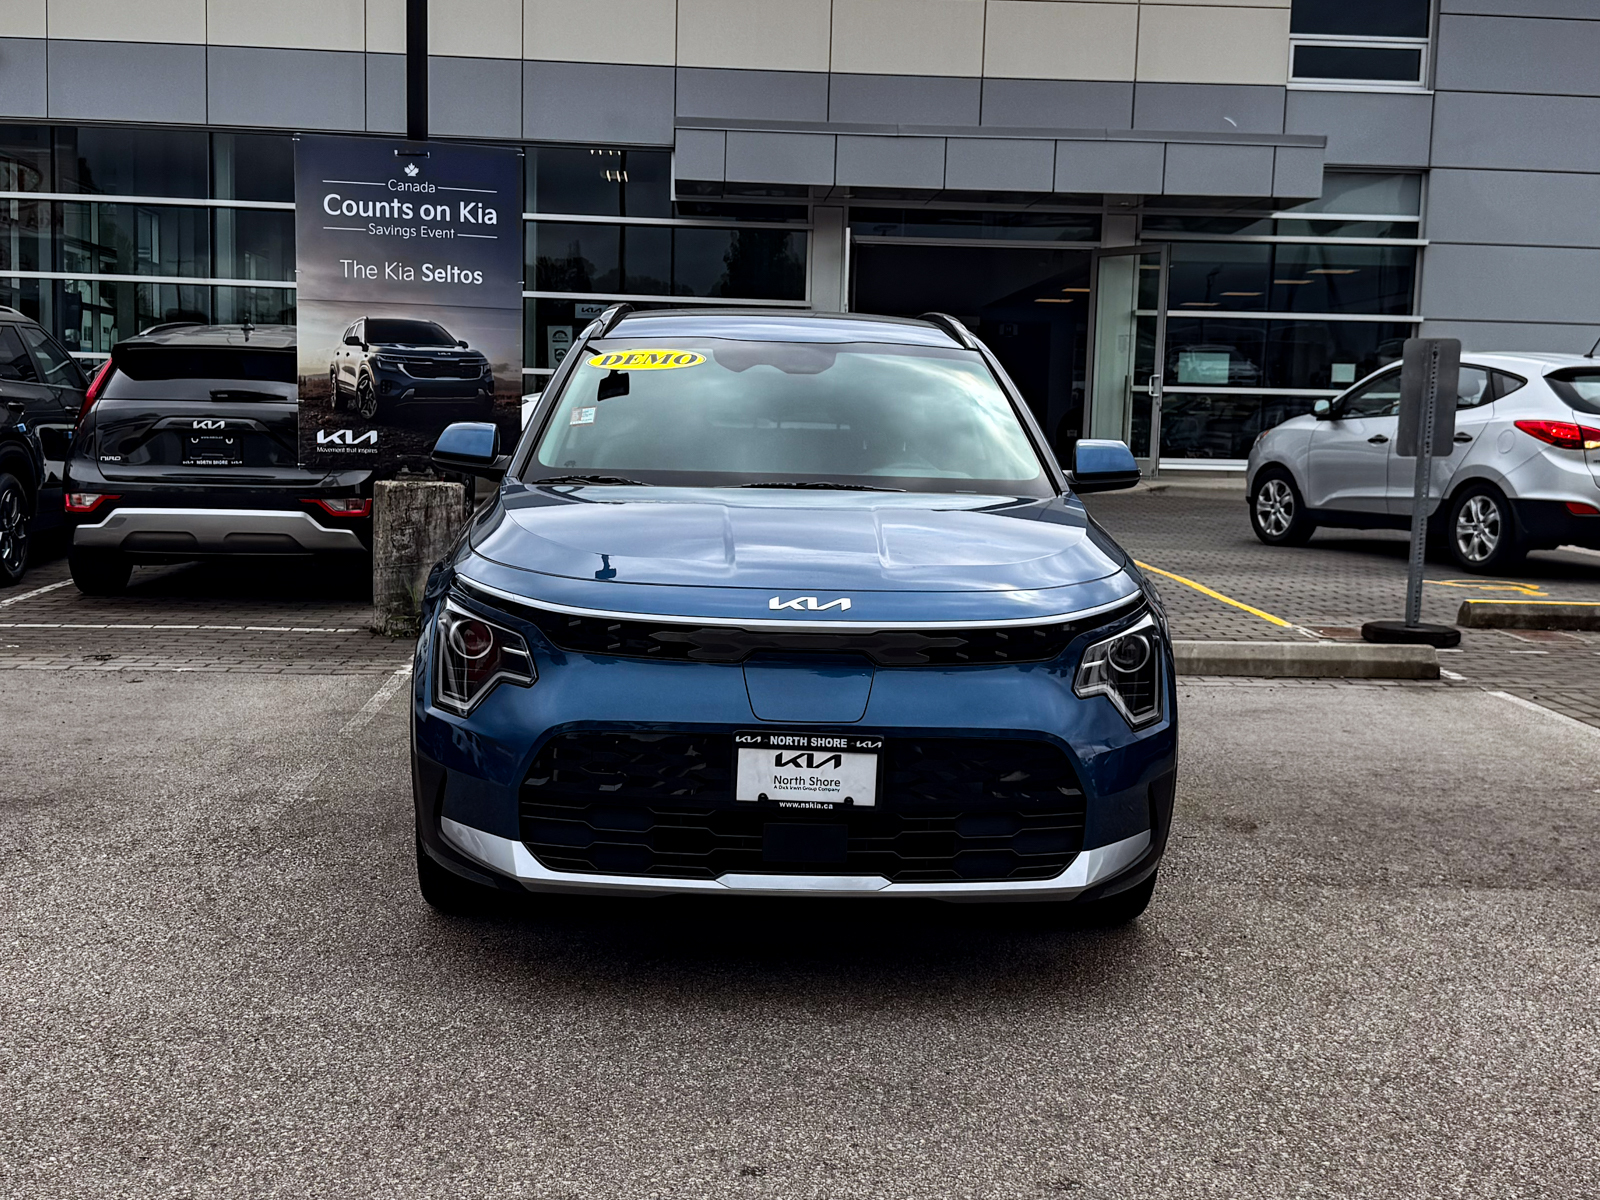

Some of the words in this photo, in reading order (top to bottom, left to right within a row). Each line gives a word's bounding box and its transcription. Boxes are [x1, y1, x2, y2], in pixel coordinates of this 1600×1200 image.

[388, 179, 436, 193] Canada
[323, 193, 414, 220] Counts
[420, 204, 450, 221] on
[460, 201, 498, 225] Kia
[368, 223, 417, 239] Savings
[421, 226, 455, 239] Event
[340, 259, 378, 280] The
[385, 262, 415, 281] Kia
[421, 263, 483, 284] Seltos
[600, 353, 698, 365] DEMO
[193, 420, 225, 429] KIA
[317, 429, 378, 445] KIA
[769, 596, 852, 612] KIA
[735, 735, 761, 743] KIA
[770, 735, 808, 746] NORTH
[810, 737, 848, 748] SHORE
[856, 740, 882, 748] KIA
[775, 751, 842, 770] KIA
[773, 774, 806, 786] North
[808, 776, 841, 787] Shore
[779, 801, 834, 810] www.nskia.ca
